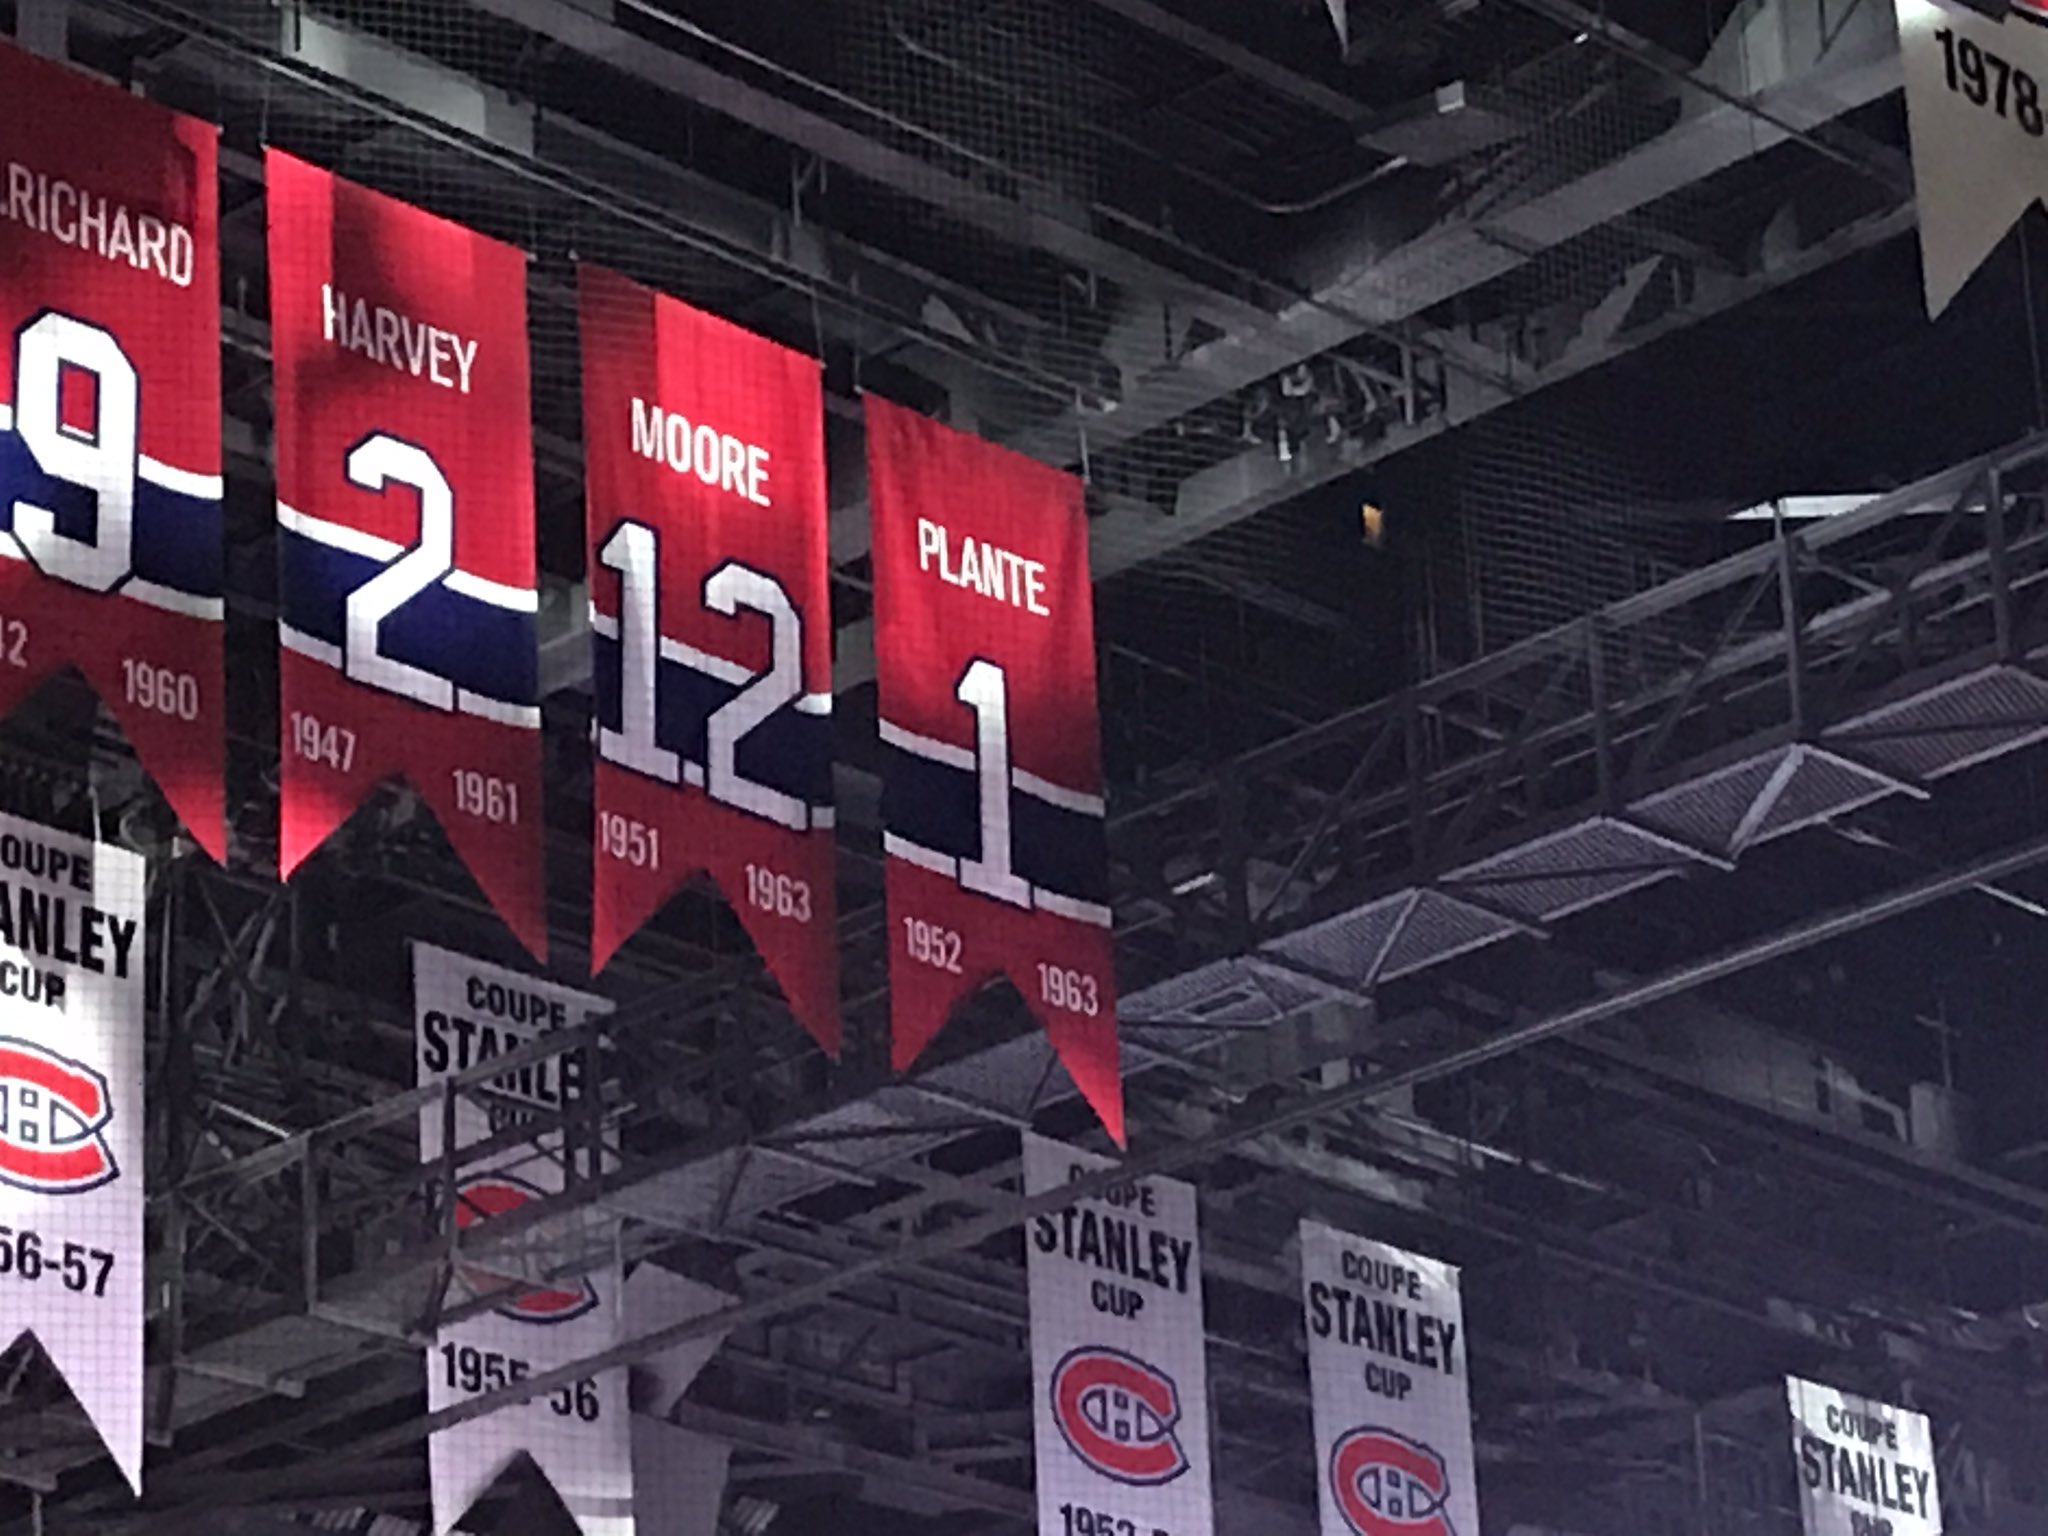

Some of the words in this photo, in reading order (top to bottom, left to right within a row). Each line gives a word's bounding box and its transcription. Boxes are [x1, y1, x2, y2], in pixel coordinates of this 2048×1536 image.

[1934, 28, 2044, 137] 1978
[322, 284, 477, 393] HARVEY
[631, 397, 770, 507] MOORE
[346, 434, 456, 712] 2
[917, 518, 1049, 616] PLANTE
[122, 659, 198, 720] 1960
[599, 520, 807, 831] 12
[290, 712, 356, 773] 1947
[453, 768, 518, 824] 1961
[957, 658, 1032, 910] 1
[601, 811, 658, 871] 1951
[745, 864, 812, 922] 1963
[0, 960, 66, 1007] CUP
[466, 976, 567, 1030] COUPE
[904, 917, 963, 974] 1952
[1037, 963, 1098, 1016] 1963
[423, 1010, 588, 1103] STANLE
[1034, 1206, 1192, 1293] STANLEY
[1342, 1250, 1422, 1301] COUPE
[1092, 1279, 1143, 1319] CUP
[1311, 1281, 1455, 1375] STANLEY
[1365, 1362, 1412, 1401] CUP
[1826, 1404, 1899, 1450] COUPE
[1801, 1434, 1929, 1519] STANLEY
